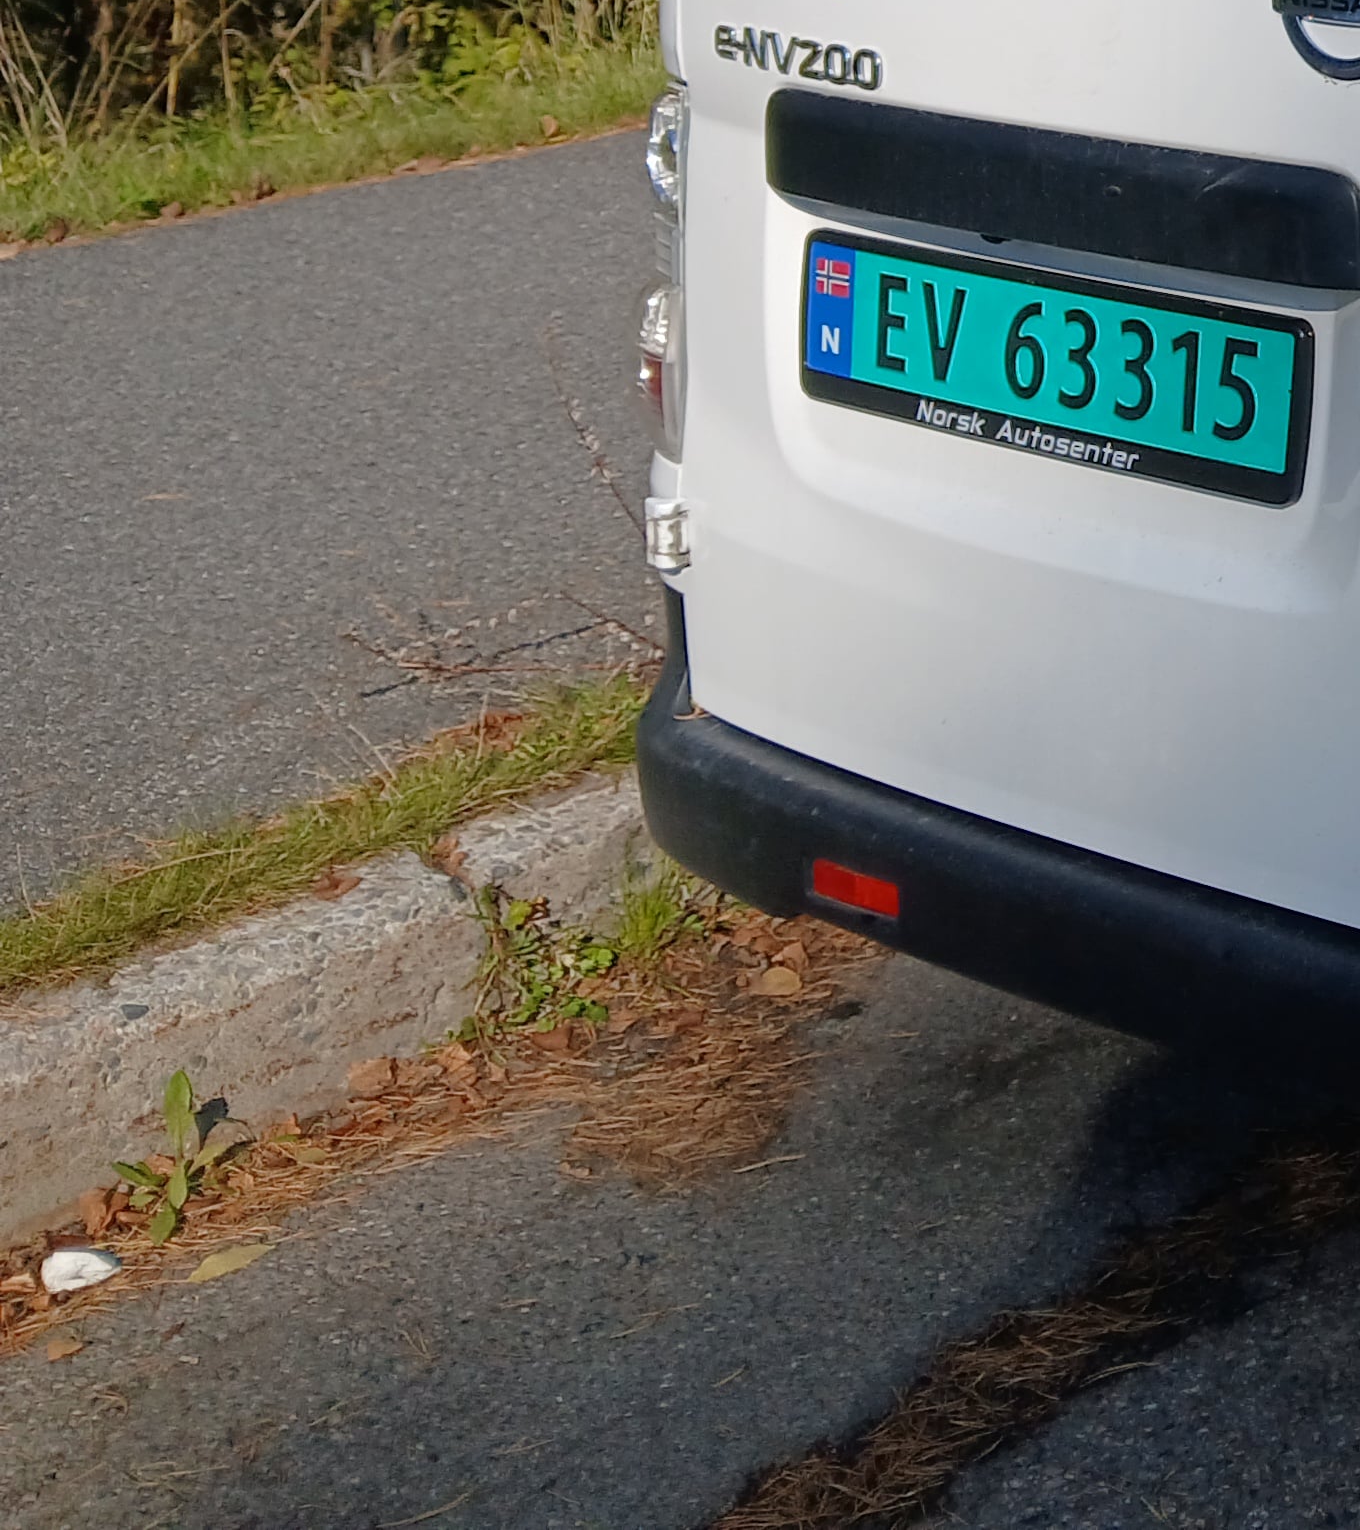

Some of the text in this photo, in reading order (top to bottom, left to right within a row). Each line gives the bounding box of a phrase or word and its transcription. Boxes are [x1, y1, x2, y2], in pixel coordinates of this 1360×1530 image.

[820, 326, 840, 354] N
[876, 271, 1261, 442] EV 63315
[916, 399, 1141, 470] Norsk Autosenter
